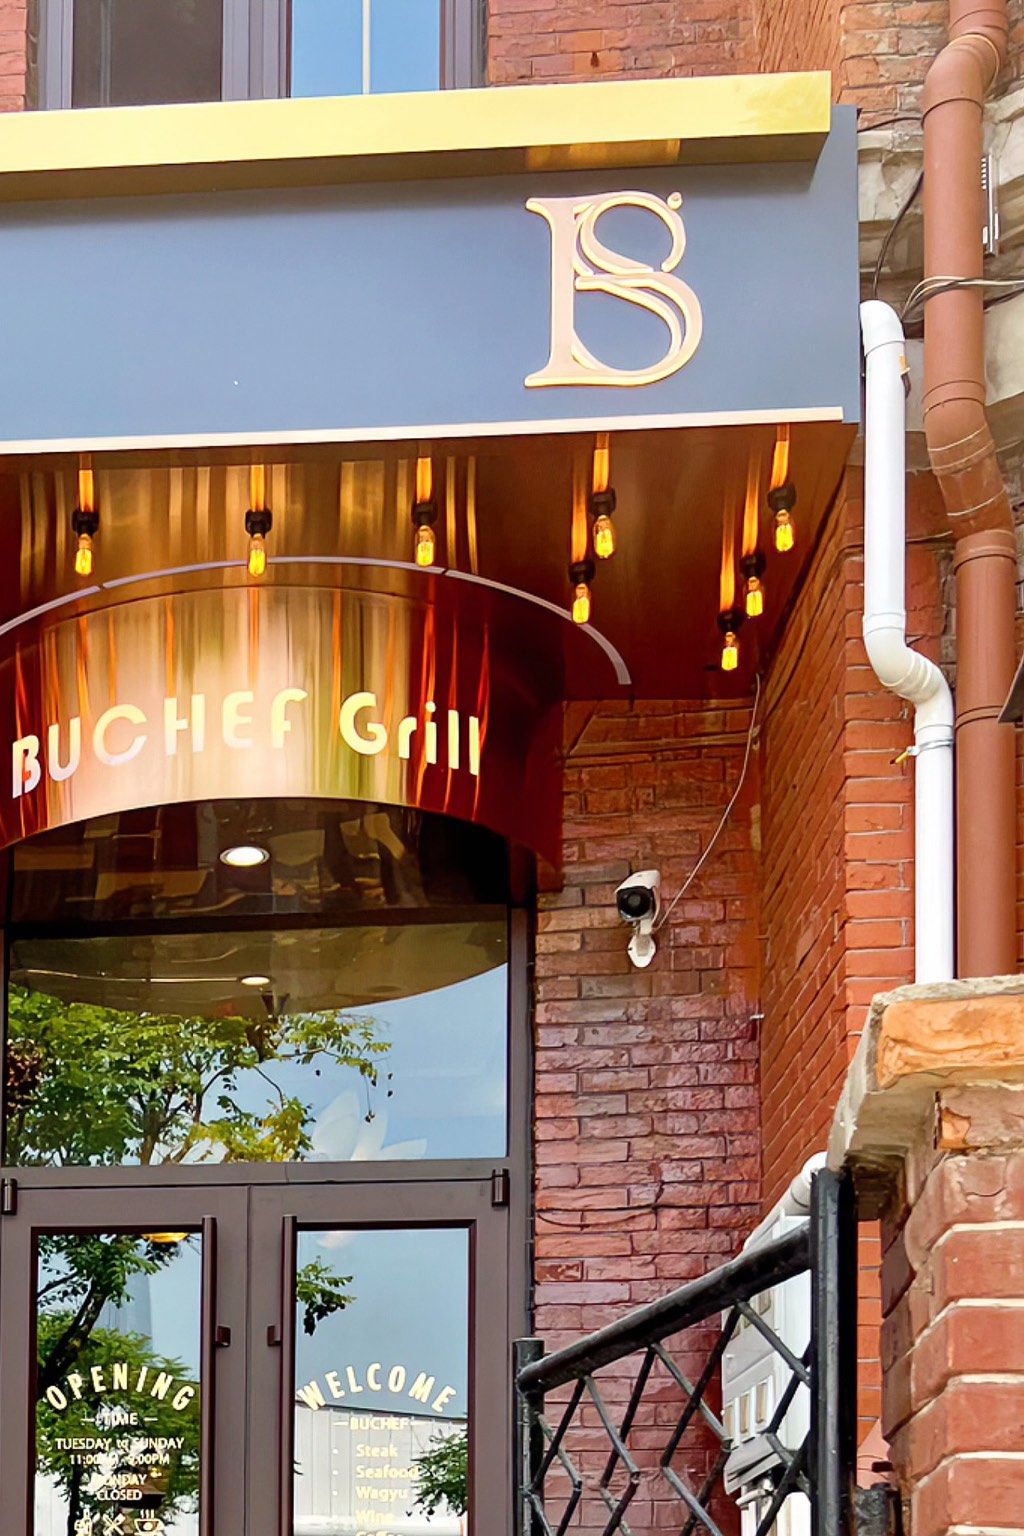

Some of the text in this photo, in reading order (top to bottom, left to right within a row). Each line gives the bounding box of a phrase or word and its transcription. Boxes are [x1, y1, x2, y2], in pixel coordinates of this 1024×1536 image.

[11, 687, 480, 799] BUCHEF Grill
[46, 1362, 195, 1411] OPENING
[296, 1362, 457, 1412] WELCOME
[103, 1412, 138, 1426] TIME
[350, 1416, 410, 1431] BUCHEF
[56, 1437, 111, 1450] TUESDAY
[132, 1437, 184, 1450] SUNDAY
[356, 1444, 398, 1457] Steak
[356, 1464, 419, 1478] Seafood
[92, 1473, 147, 1486] ONDAY
[96, 1488, 143, 1501] CLOSED
[356, 1485, 408, 1502] Wagyu
[356, 1510, 395, 1524] Wine
